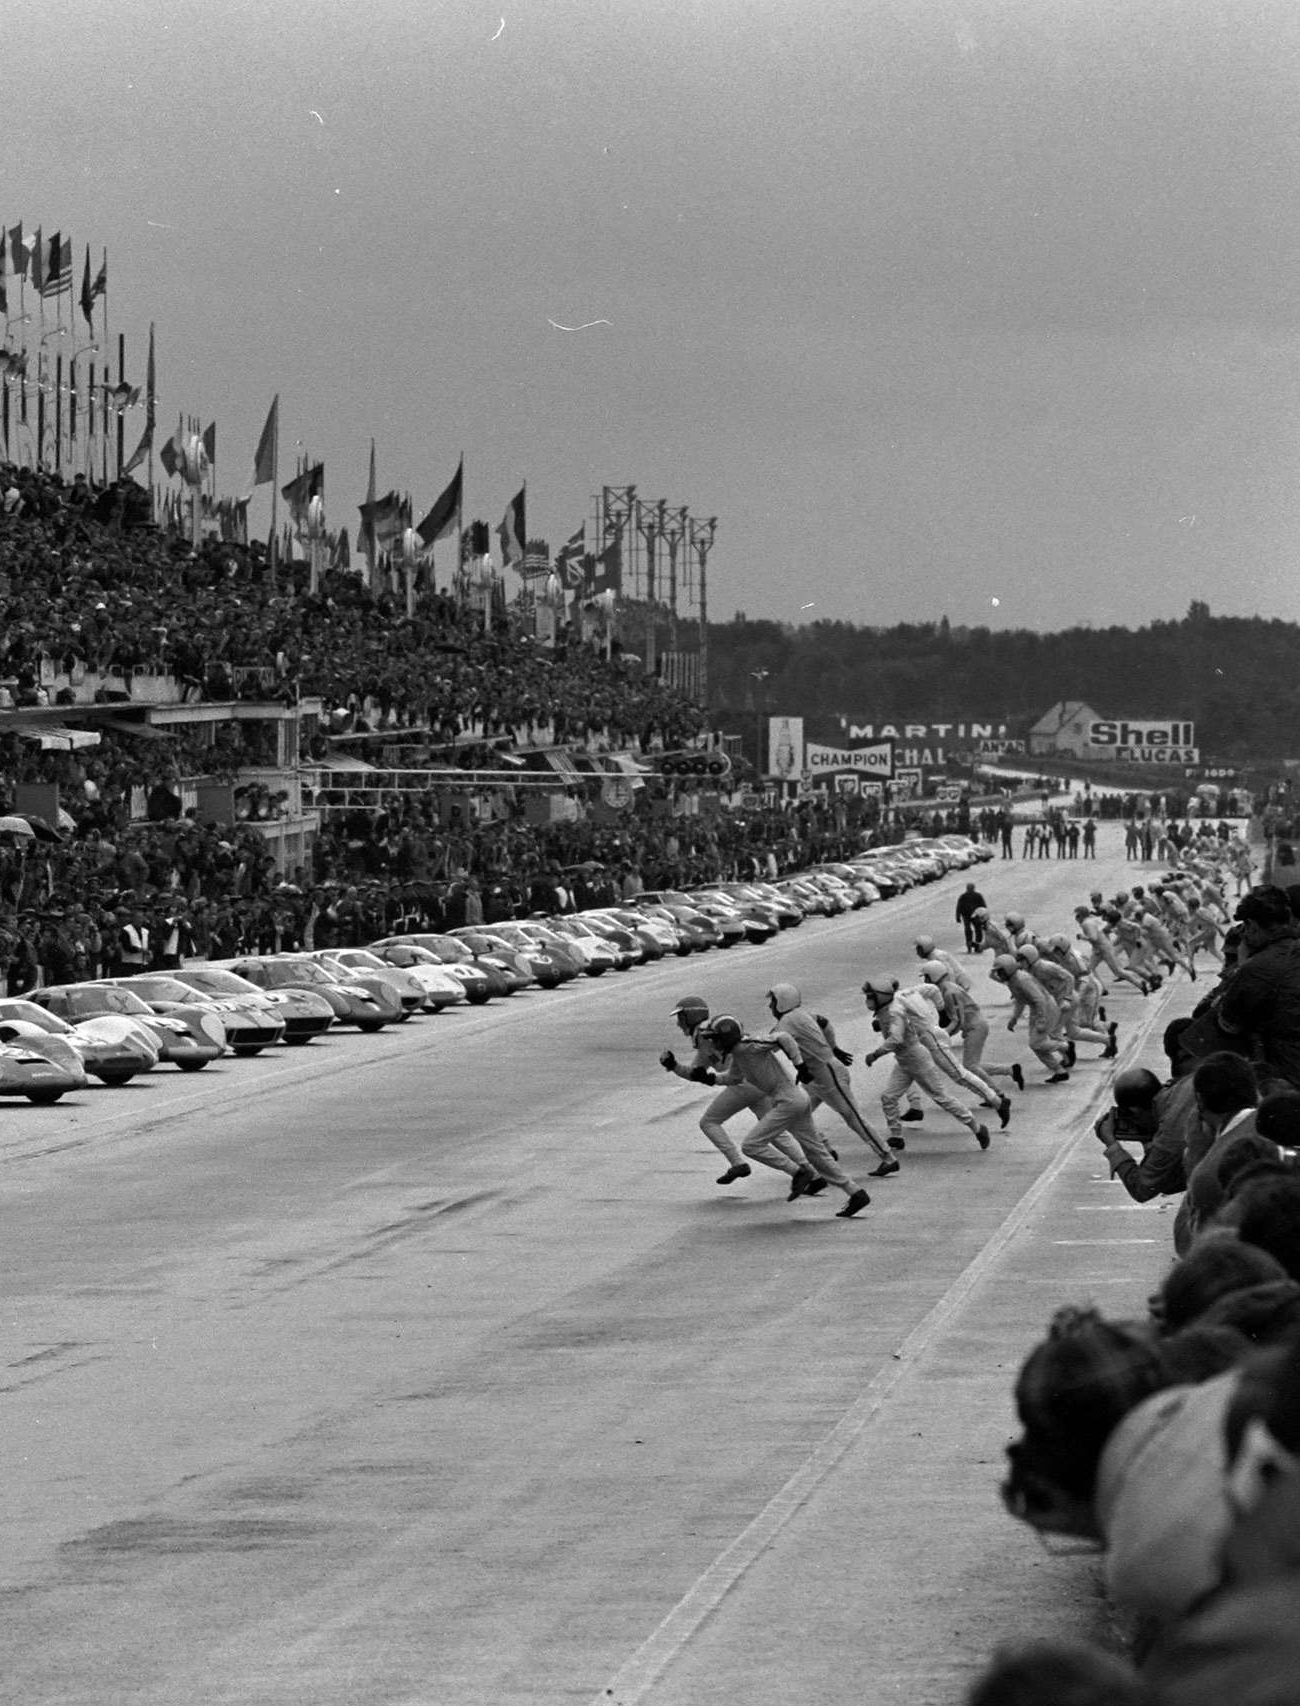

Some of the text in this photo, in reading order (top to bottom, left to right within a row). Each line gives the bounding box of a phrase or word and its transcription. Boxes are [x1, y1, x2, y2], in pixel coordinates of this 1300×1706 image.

[1090, 722, 1192, 746] Shell
[810, 753, 888, 767] CHAMPION
[1130, 749, 1194, 762] LUCAS
